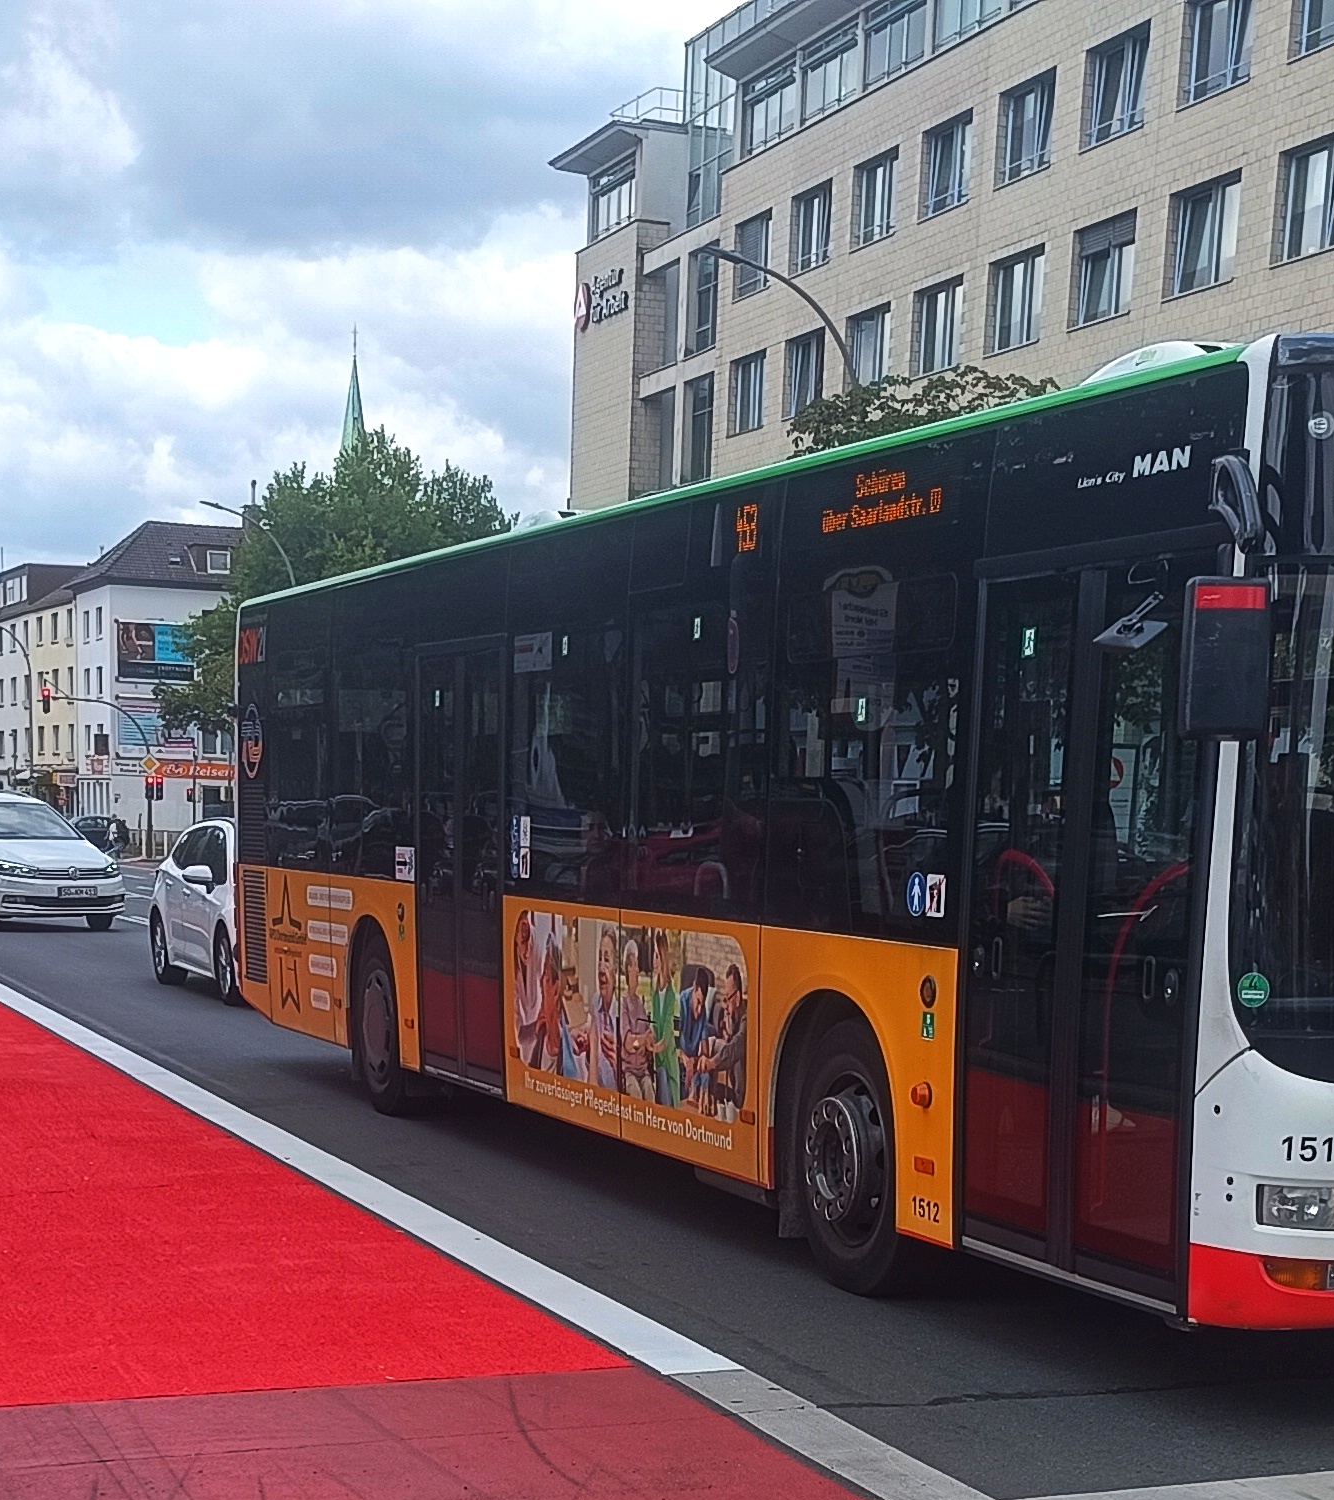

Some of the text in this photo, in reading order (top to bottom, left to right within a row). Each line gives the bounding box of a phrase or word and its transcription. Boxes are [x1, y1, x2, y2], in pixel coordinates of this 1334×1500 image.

[1105, 471, 1126, 484] City
[1132, 445, 1192, 478] MAN
[736, 504, 758, 553] 453
[524, 1071, 732, 1150] Ihr zuverlässiger Pflegedienst im Herz von Dortmund
[911, 1195, 940, 1224] 1512
